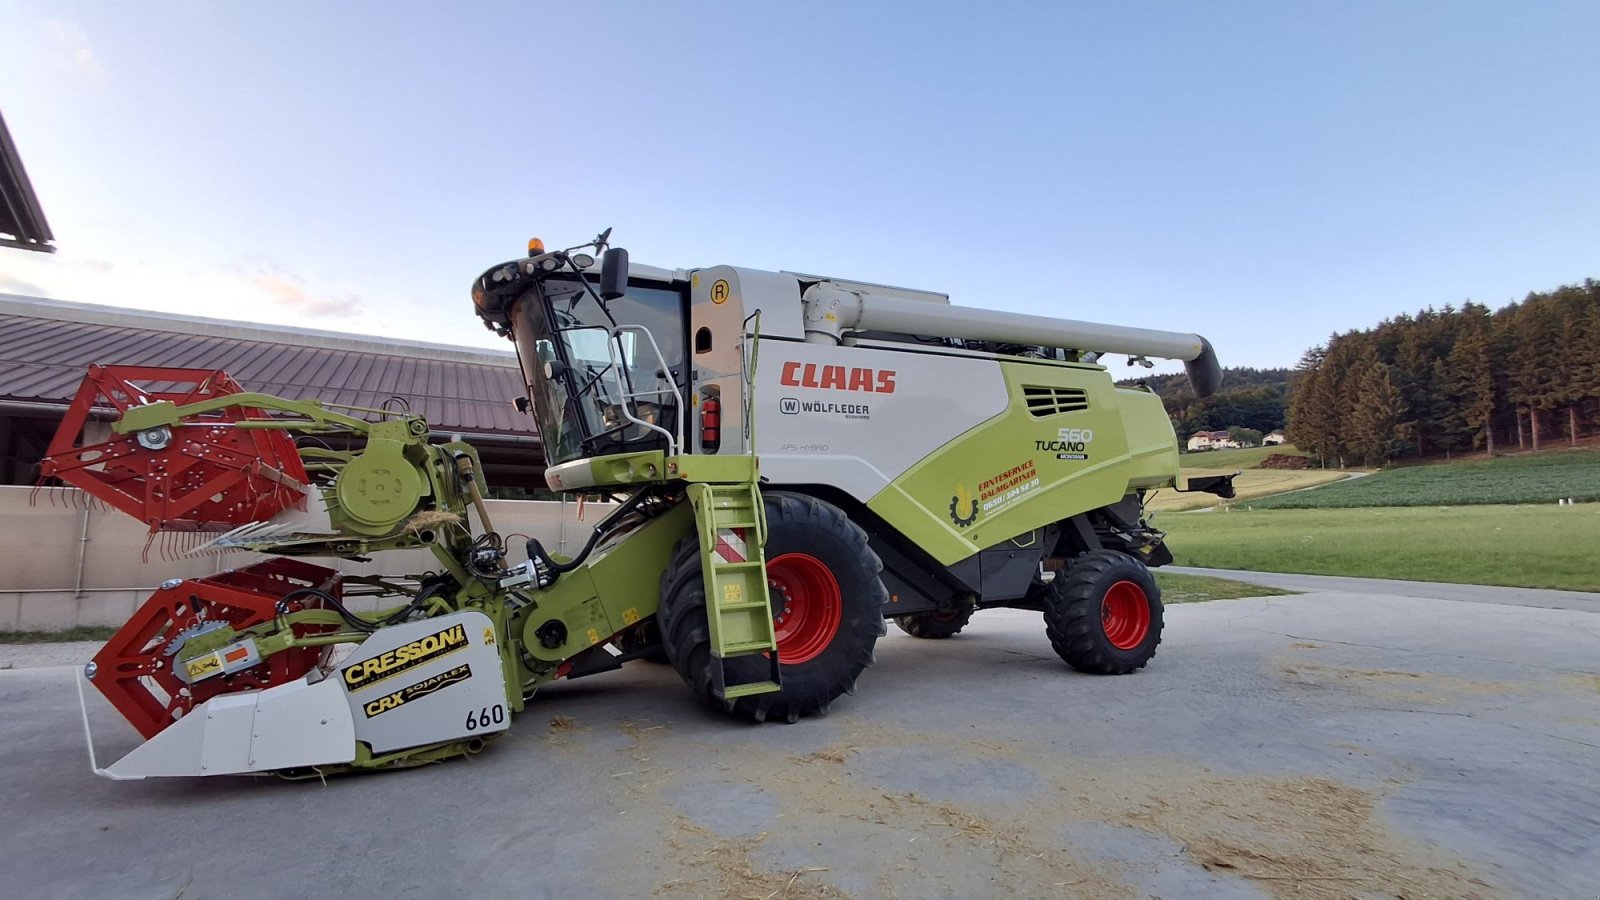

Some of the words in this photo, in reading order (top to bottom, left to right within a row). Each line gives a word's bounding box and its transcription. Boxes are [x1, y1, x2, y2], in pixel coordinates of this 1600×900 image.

[715, 284, 724, 299] R
[780, 361, 896, 394] CLAAS
[802, 400, 869, 415] WÖLFLEDER
[1035, 440, 1085, 452] TUCANO
[1058, 428, 1092, 442] 560
[978, 459, 1034, 492] ERNTESERVICE
[980, 469, 1037, 501] BAUMGARTNER
[366, 692, 404, 716] CRX
[406, 665, 469, 694] SOJAFLEX
[466, 704, 504, 731] 660
